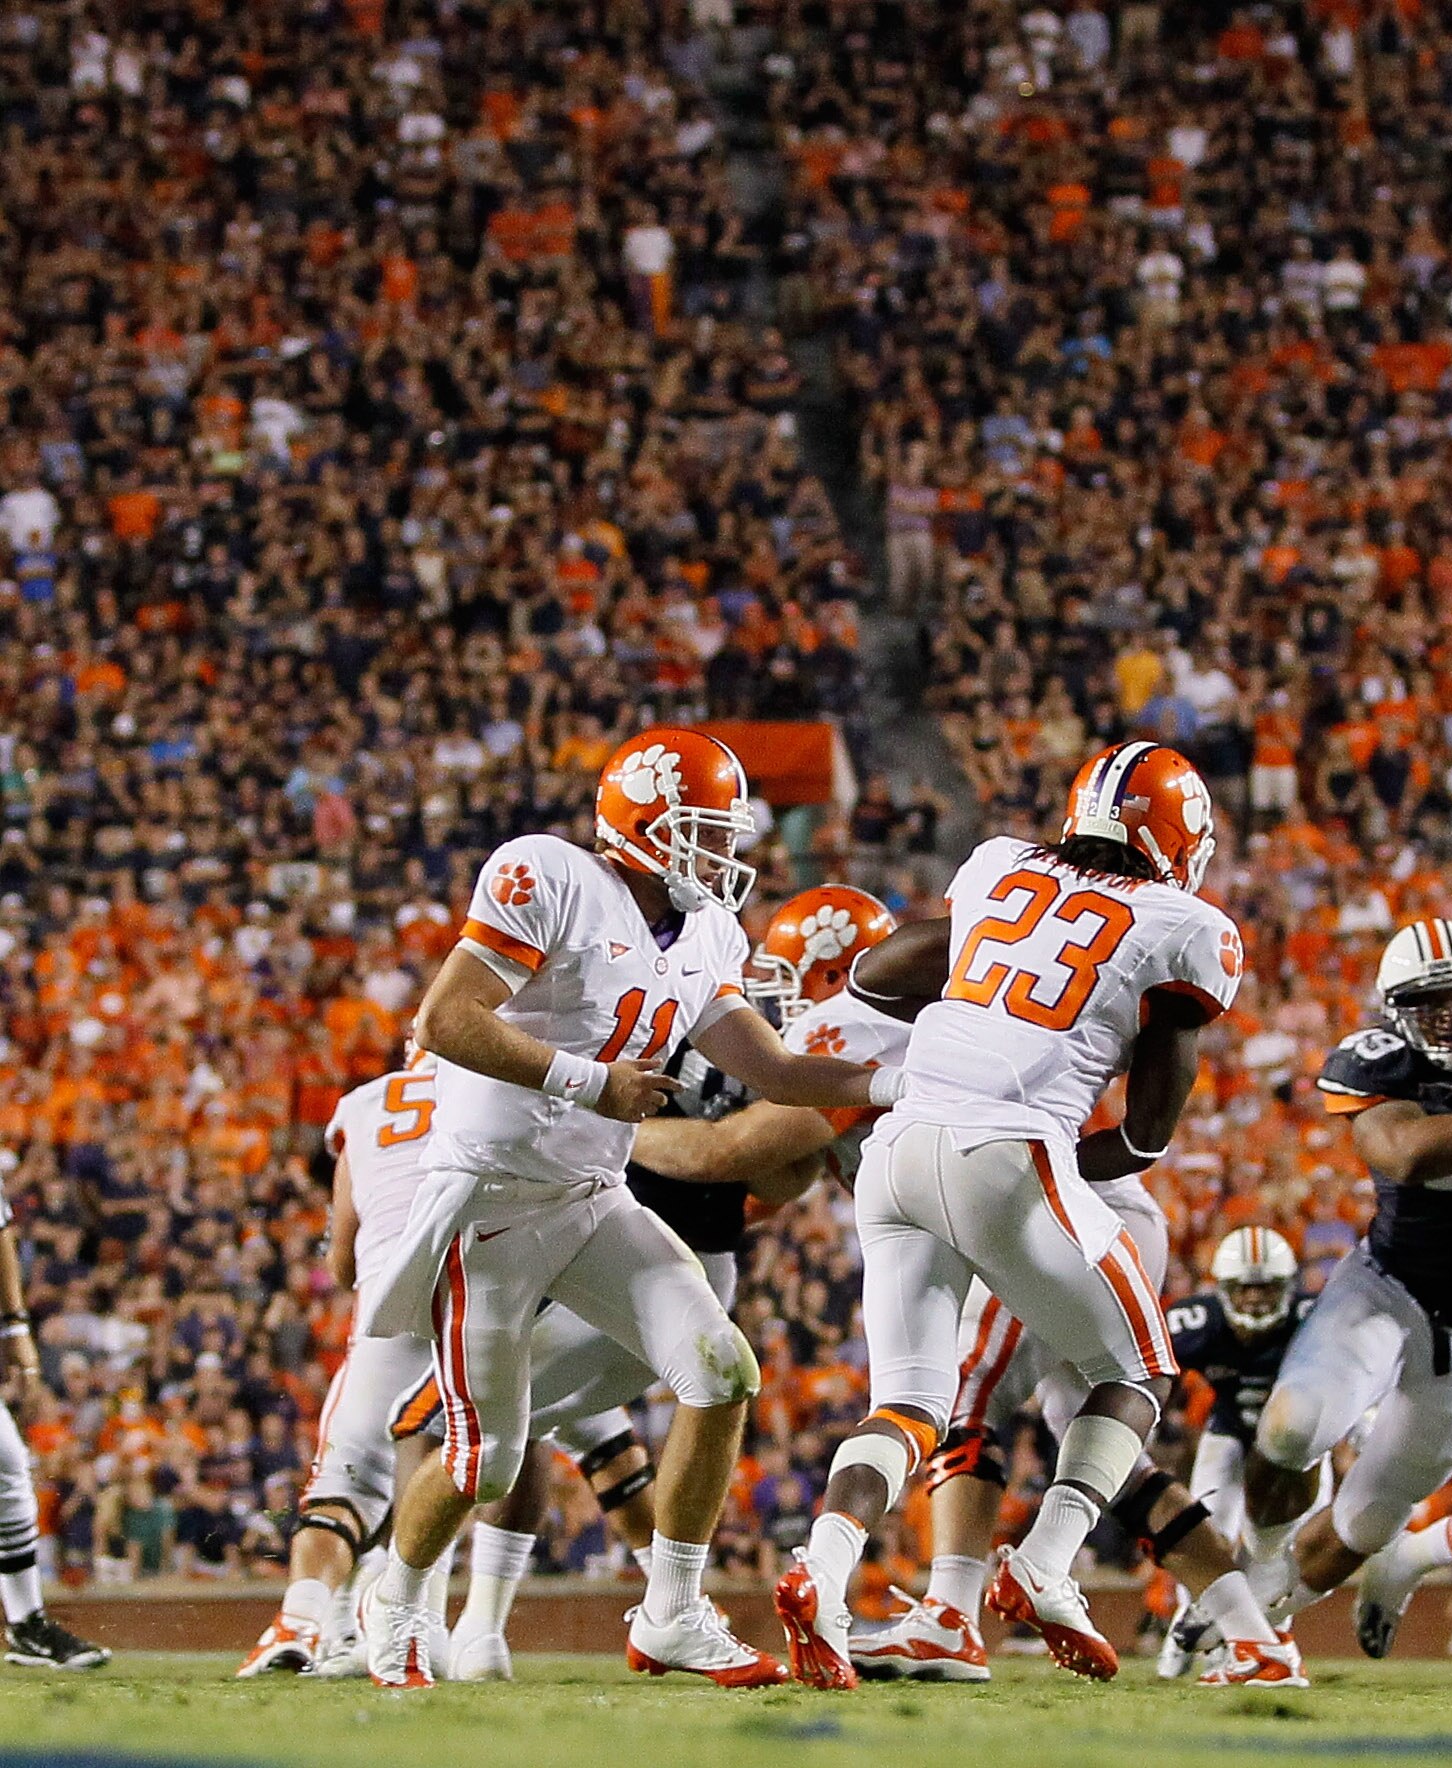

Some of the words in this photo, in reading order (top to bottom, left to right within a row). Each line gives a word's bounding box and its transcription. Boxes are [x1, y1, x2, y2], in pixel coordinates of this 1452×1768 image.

[1087, 802, 1098, 816] 2
[1110, 805, 1121, 820] 3
[944, 868, 1135, 1031] 23
[594, 987, 678, 1064] 11
[1166, 1304, 1207, 1334] 2
